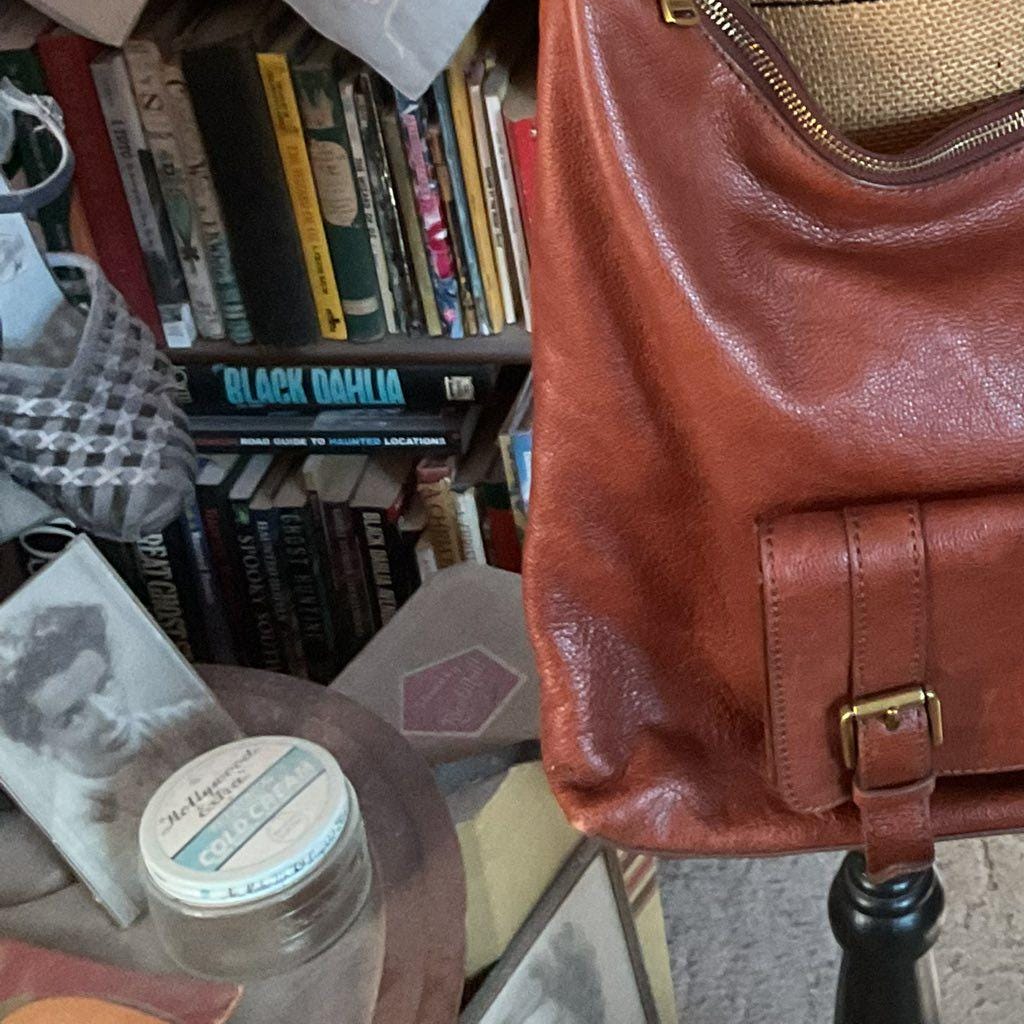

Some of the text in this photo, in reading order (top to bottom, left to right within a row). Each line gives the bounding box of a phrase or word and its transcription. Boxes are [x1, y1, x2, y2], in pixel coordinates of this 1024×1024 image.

[223, 367, 308, 405] BLACK
[311, 367, 406, 405] DAHLIA
[240, 437, 270, 446] ROAD
[273, 437, 308, 446] GUIDE
[310, 437, 326, 446] TO
[329, 437, 382, 446] HAUNTED
[384, 437, 447, 446] LOCATIONS
[238, 534, 266, 602] SPOOKY
[199, 818, 248, 868] COLD
[250, 761, 316, 819] CREAM
